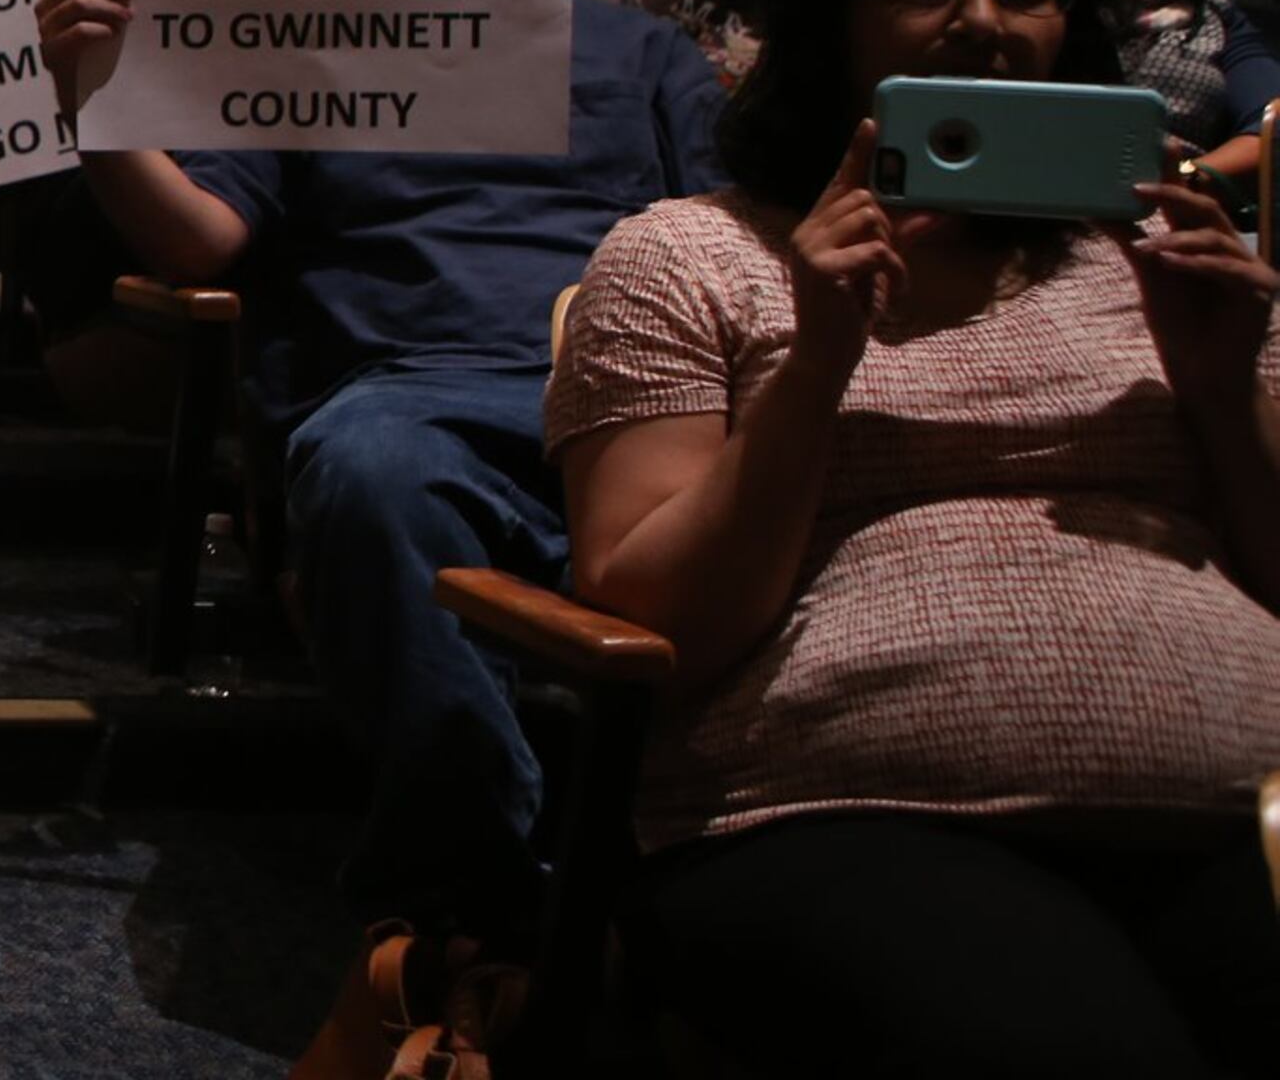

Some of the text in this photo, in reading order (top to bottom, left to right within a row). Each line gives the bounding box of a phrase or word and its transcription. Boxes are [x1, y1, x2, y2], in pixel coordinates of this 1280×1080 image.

[153, 12, 491, 49] TO GWINNETT
[221, 90, 418, 128] COUNTY
